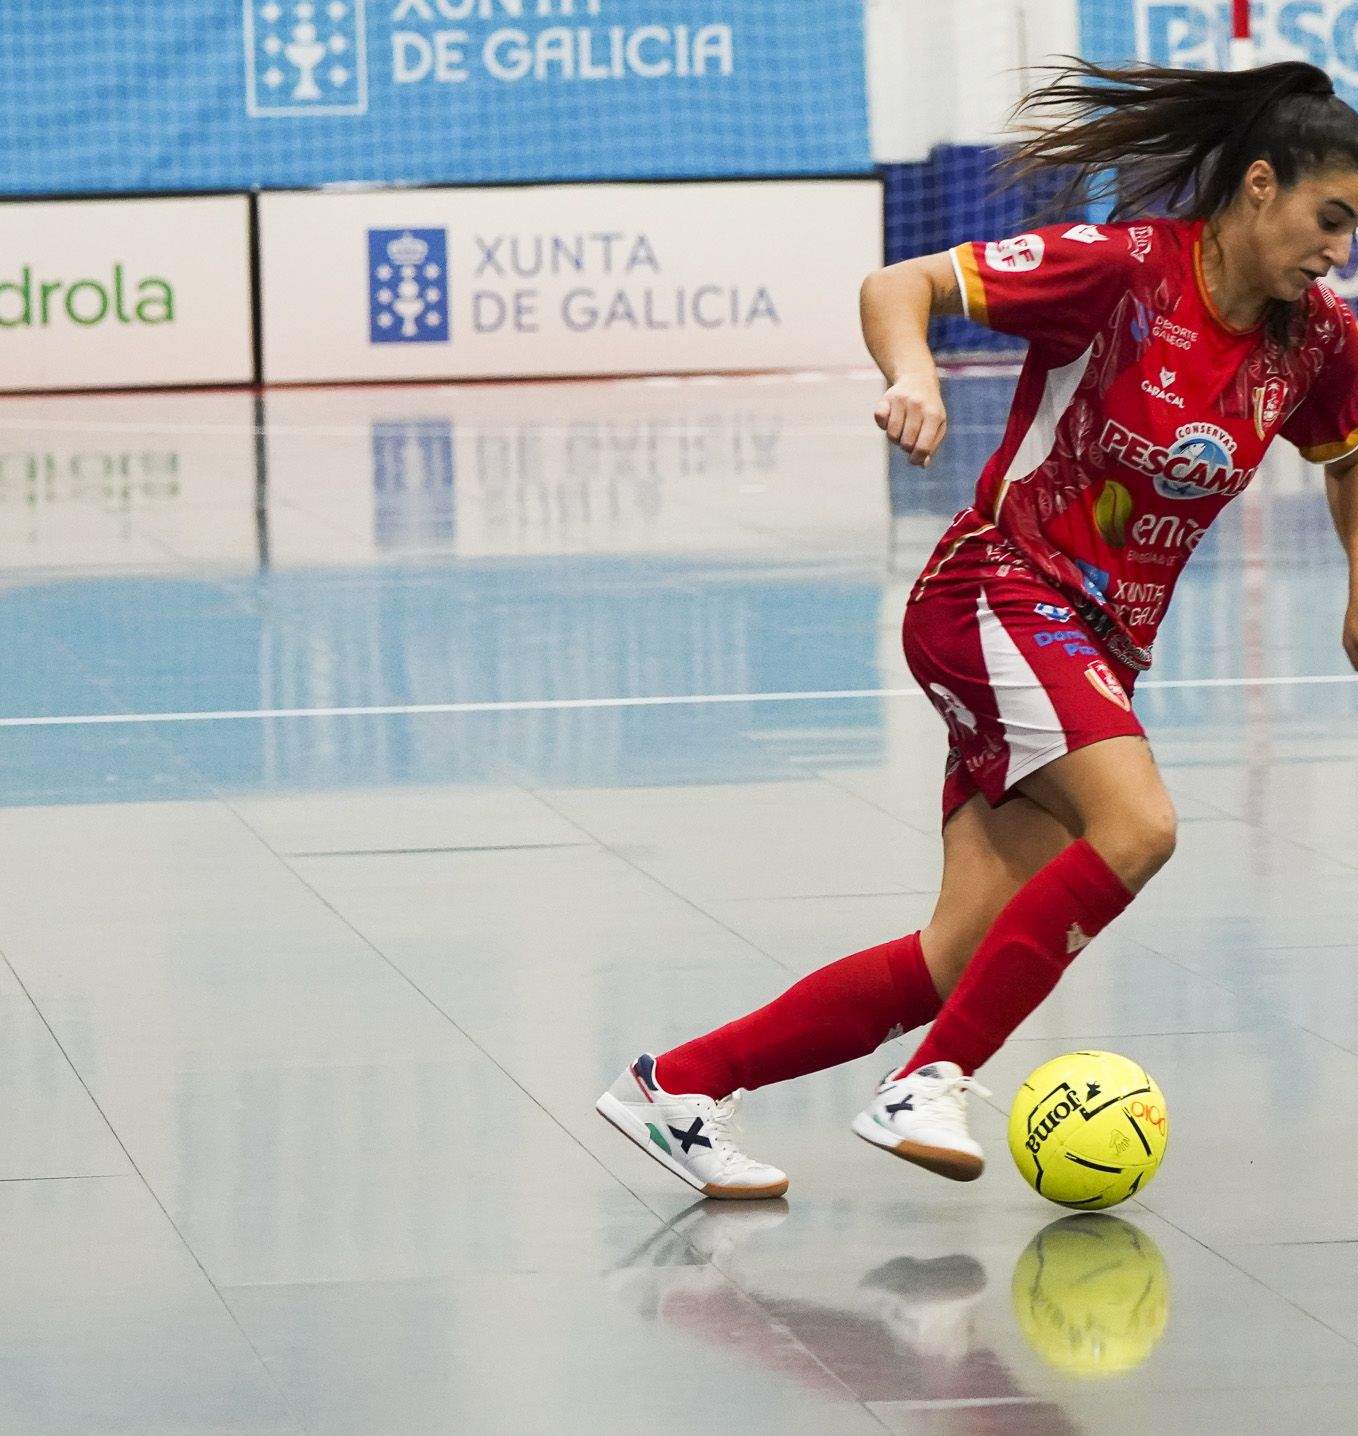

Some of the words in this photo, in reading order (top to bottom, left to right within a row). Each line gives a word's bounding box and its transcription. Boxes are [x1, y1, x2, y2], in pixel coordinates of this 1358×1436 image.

[392, 30, 470, 84] DE
[482, 24, 735, 82] GALICIA
[473, 231, 662, 279] XUNTA
[472, 288, 540, 335] DE
[560, 283, 783, 332] GALICIA
[1140, 379, 1186, 409] CARACAL
[1177, 424, 1236, 453] CONSERVAS
